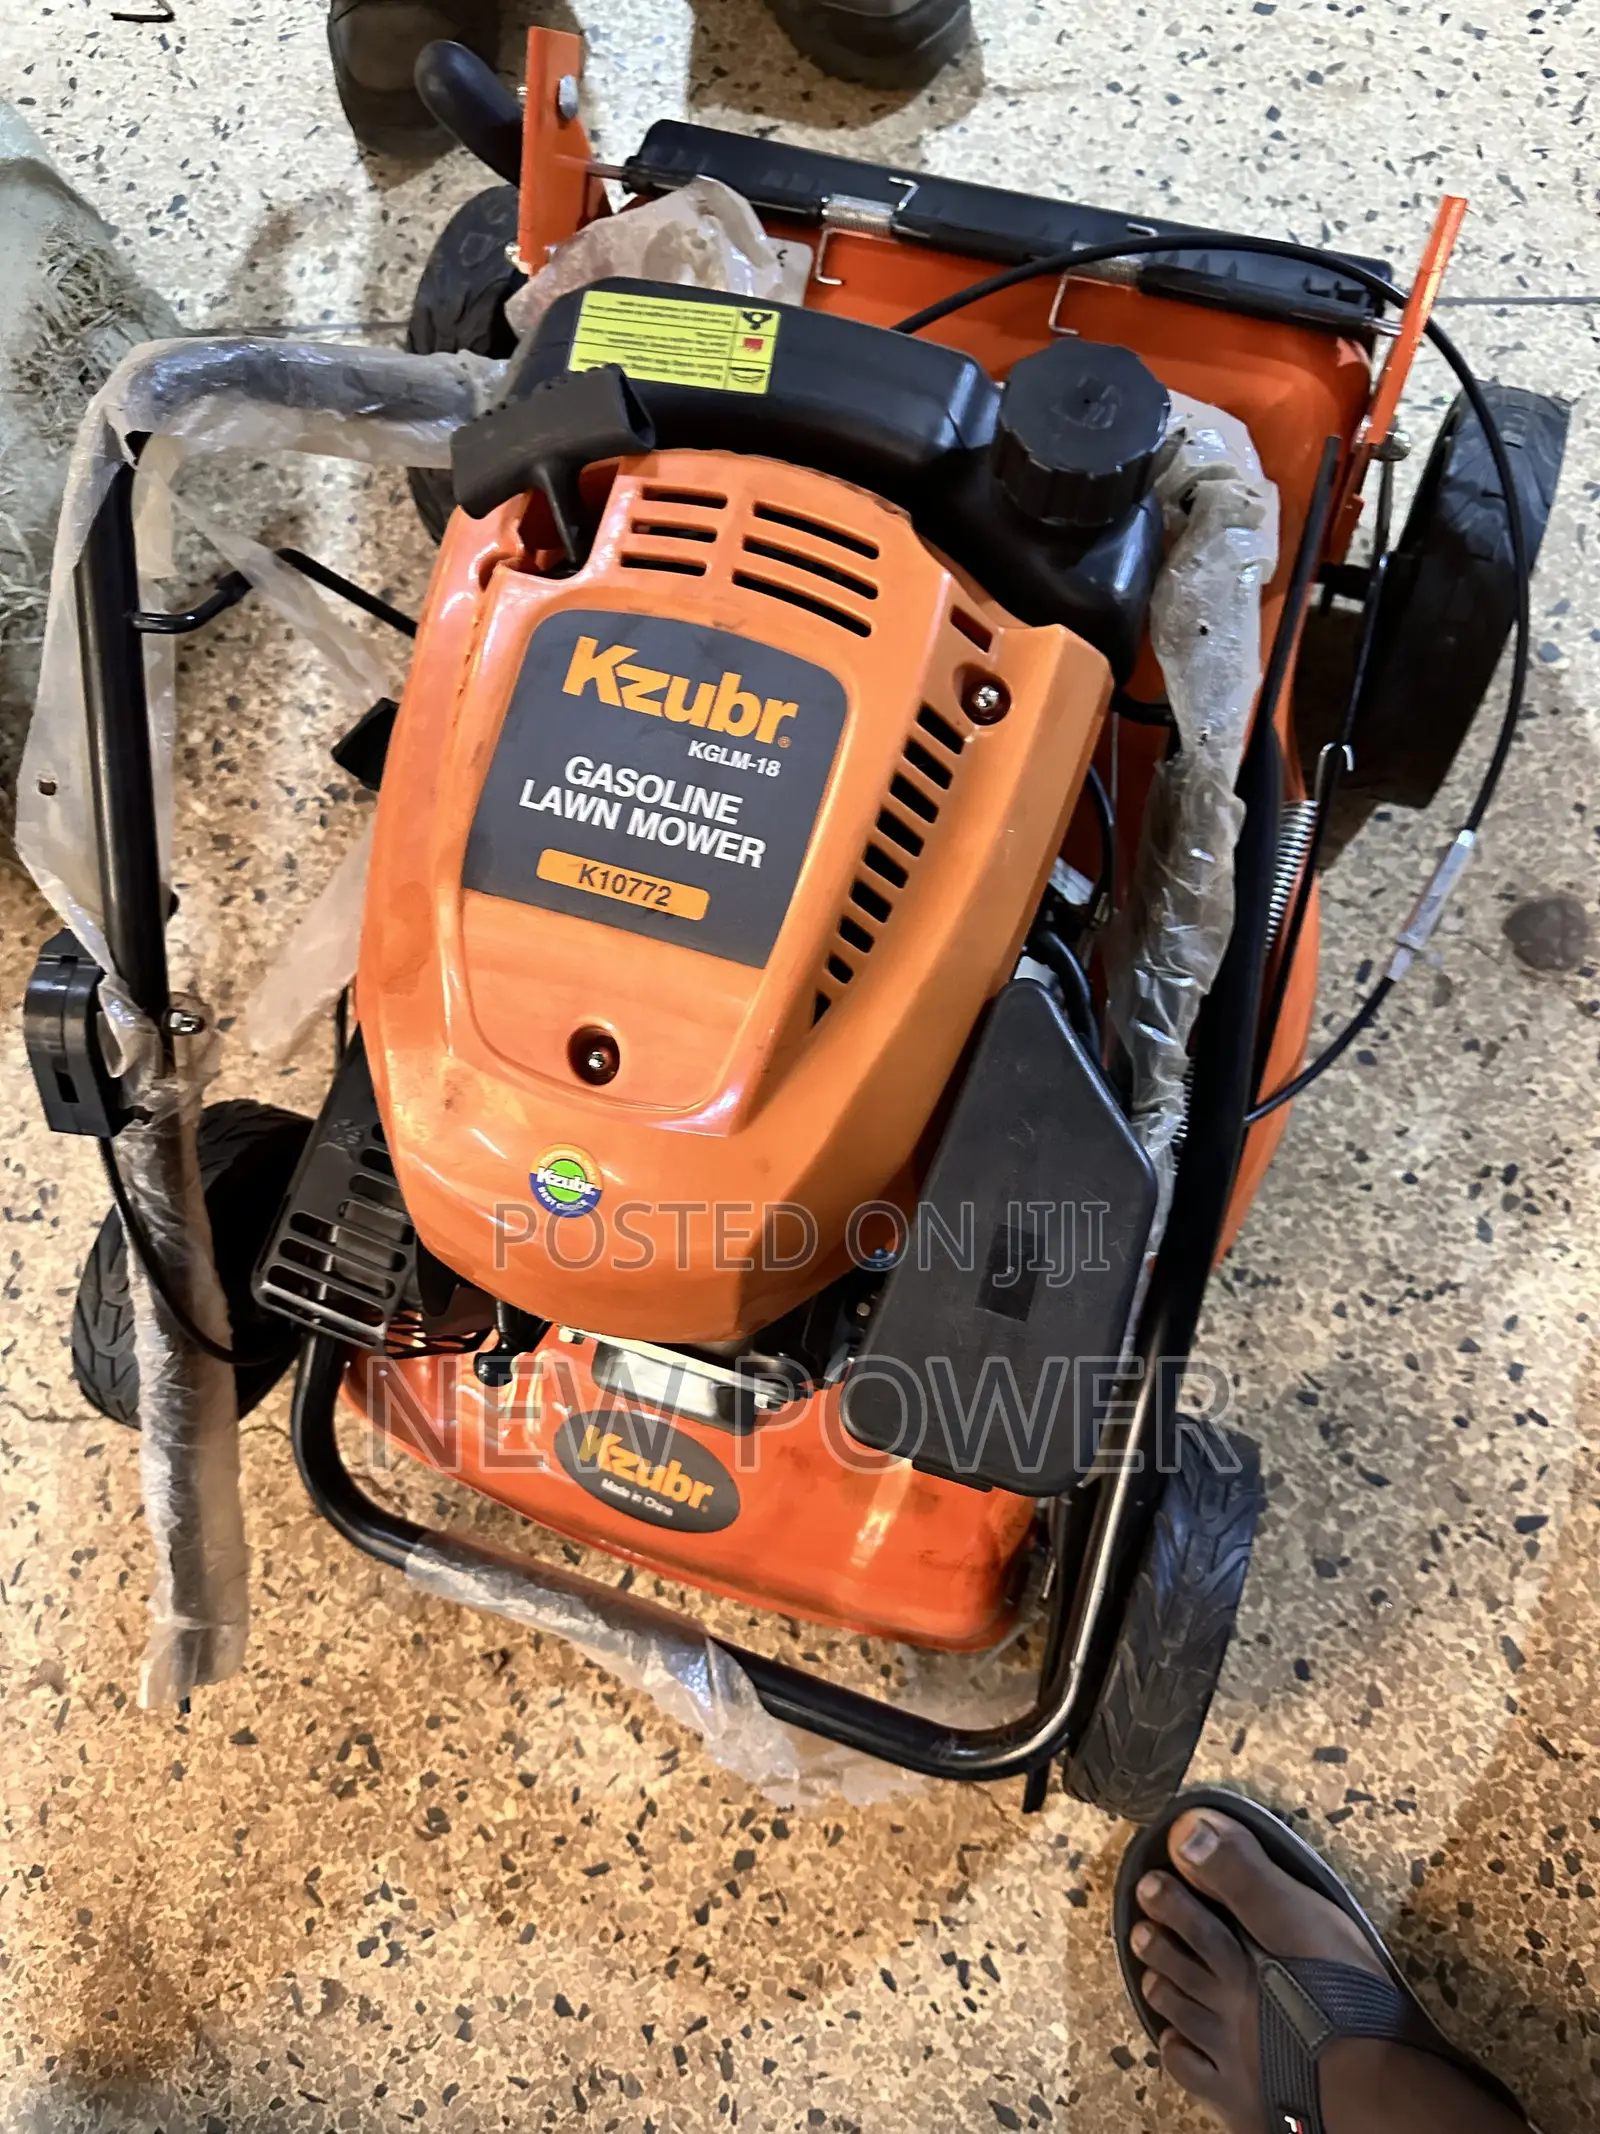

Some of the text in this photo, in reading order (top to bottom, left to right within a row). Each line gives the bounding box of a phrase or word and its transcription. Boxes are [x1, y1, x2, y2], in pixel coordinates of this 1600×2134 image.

[562, 636, 799, 744] Kzubr
[564, 756, 744, 825] GASOLINE
[687, 740, 782, 777] KGLM-18
[519, 779, 767, 869] LAWN MOWER
[578, 863, 673, 907] K10772
[578, 1424, 714, 1509] Kzubr
[601, 1478, 631, 1498] Made
[631, 1491, 643, 1505] in
